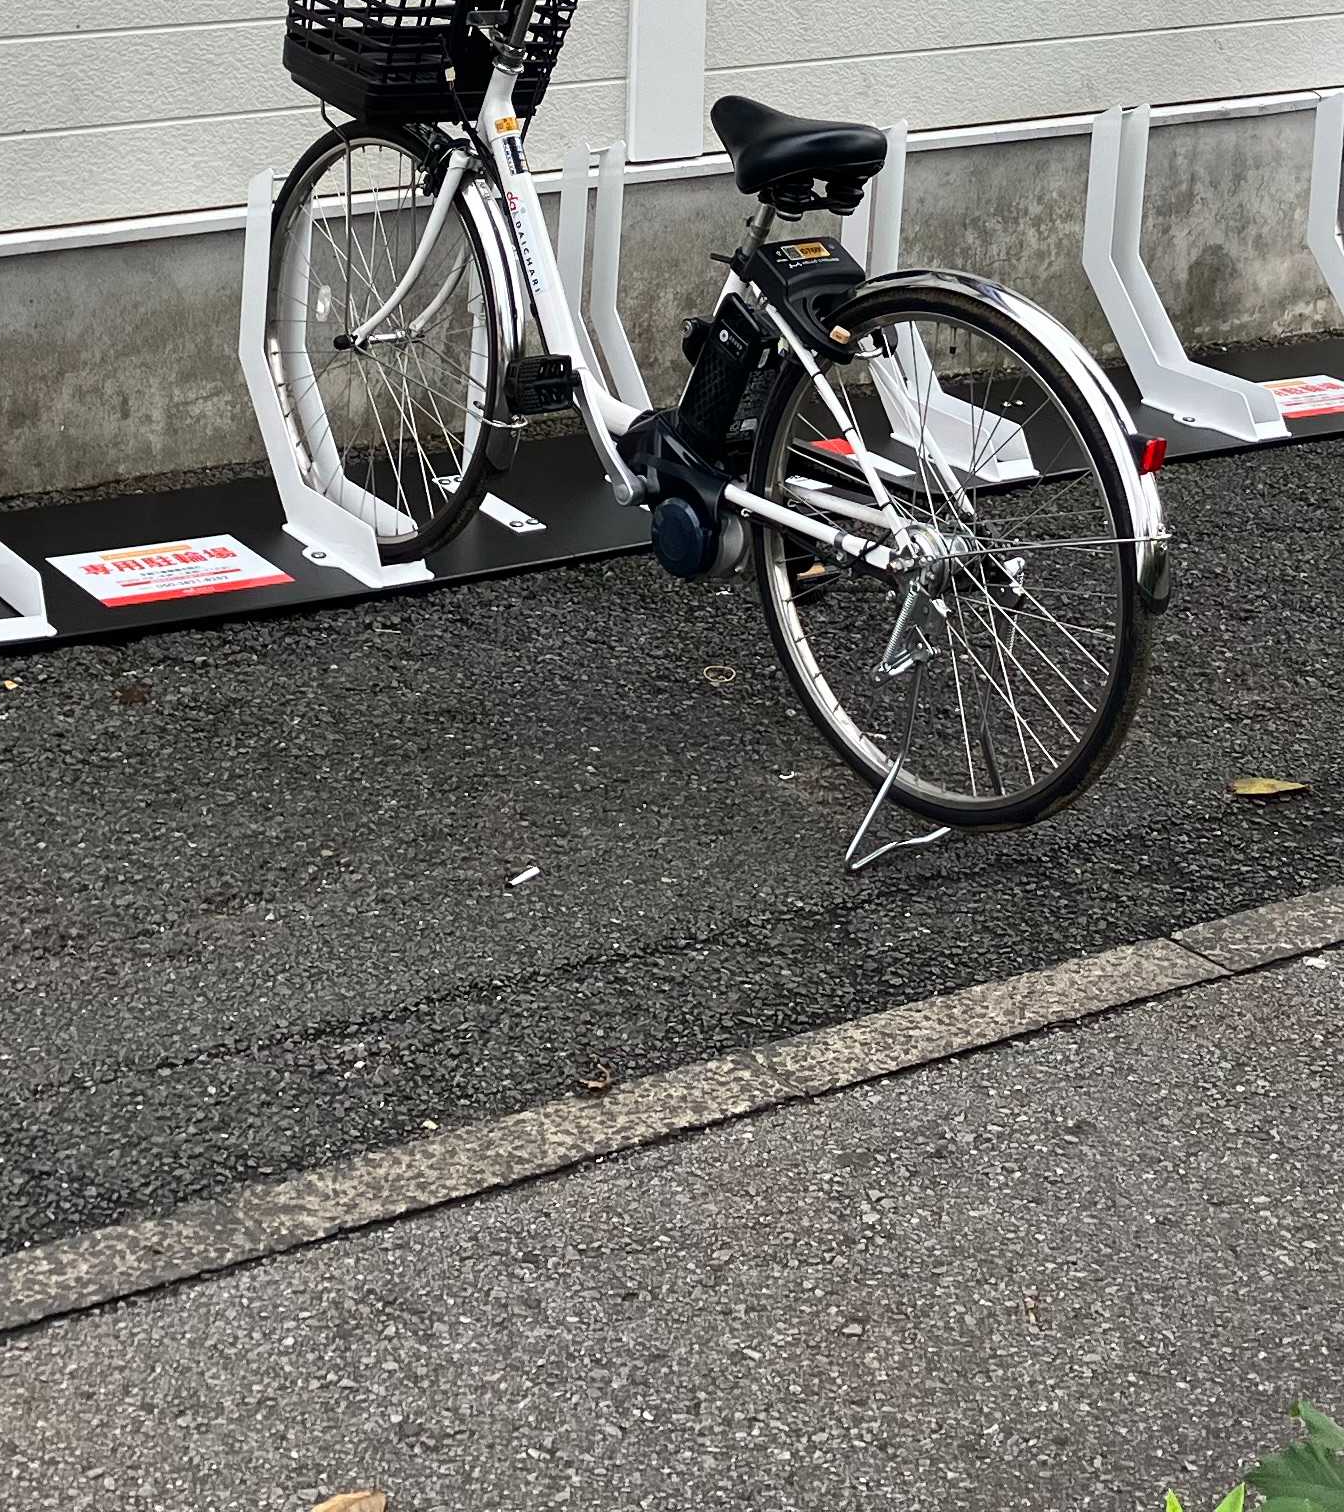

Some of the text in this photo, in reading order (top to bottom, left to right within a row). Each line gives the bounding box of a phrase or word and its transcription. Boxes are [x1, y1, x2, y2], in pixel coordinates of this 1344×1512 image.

[516, 221, 541, 293] DAICHARI
[79, 546, 238, 576] 専用駐輪場
